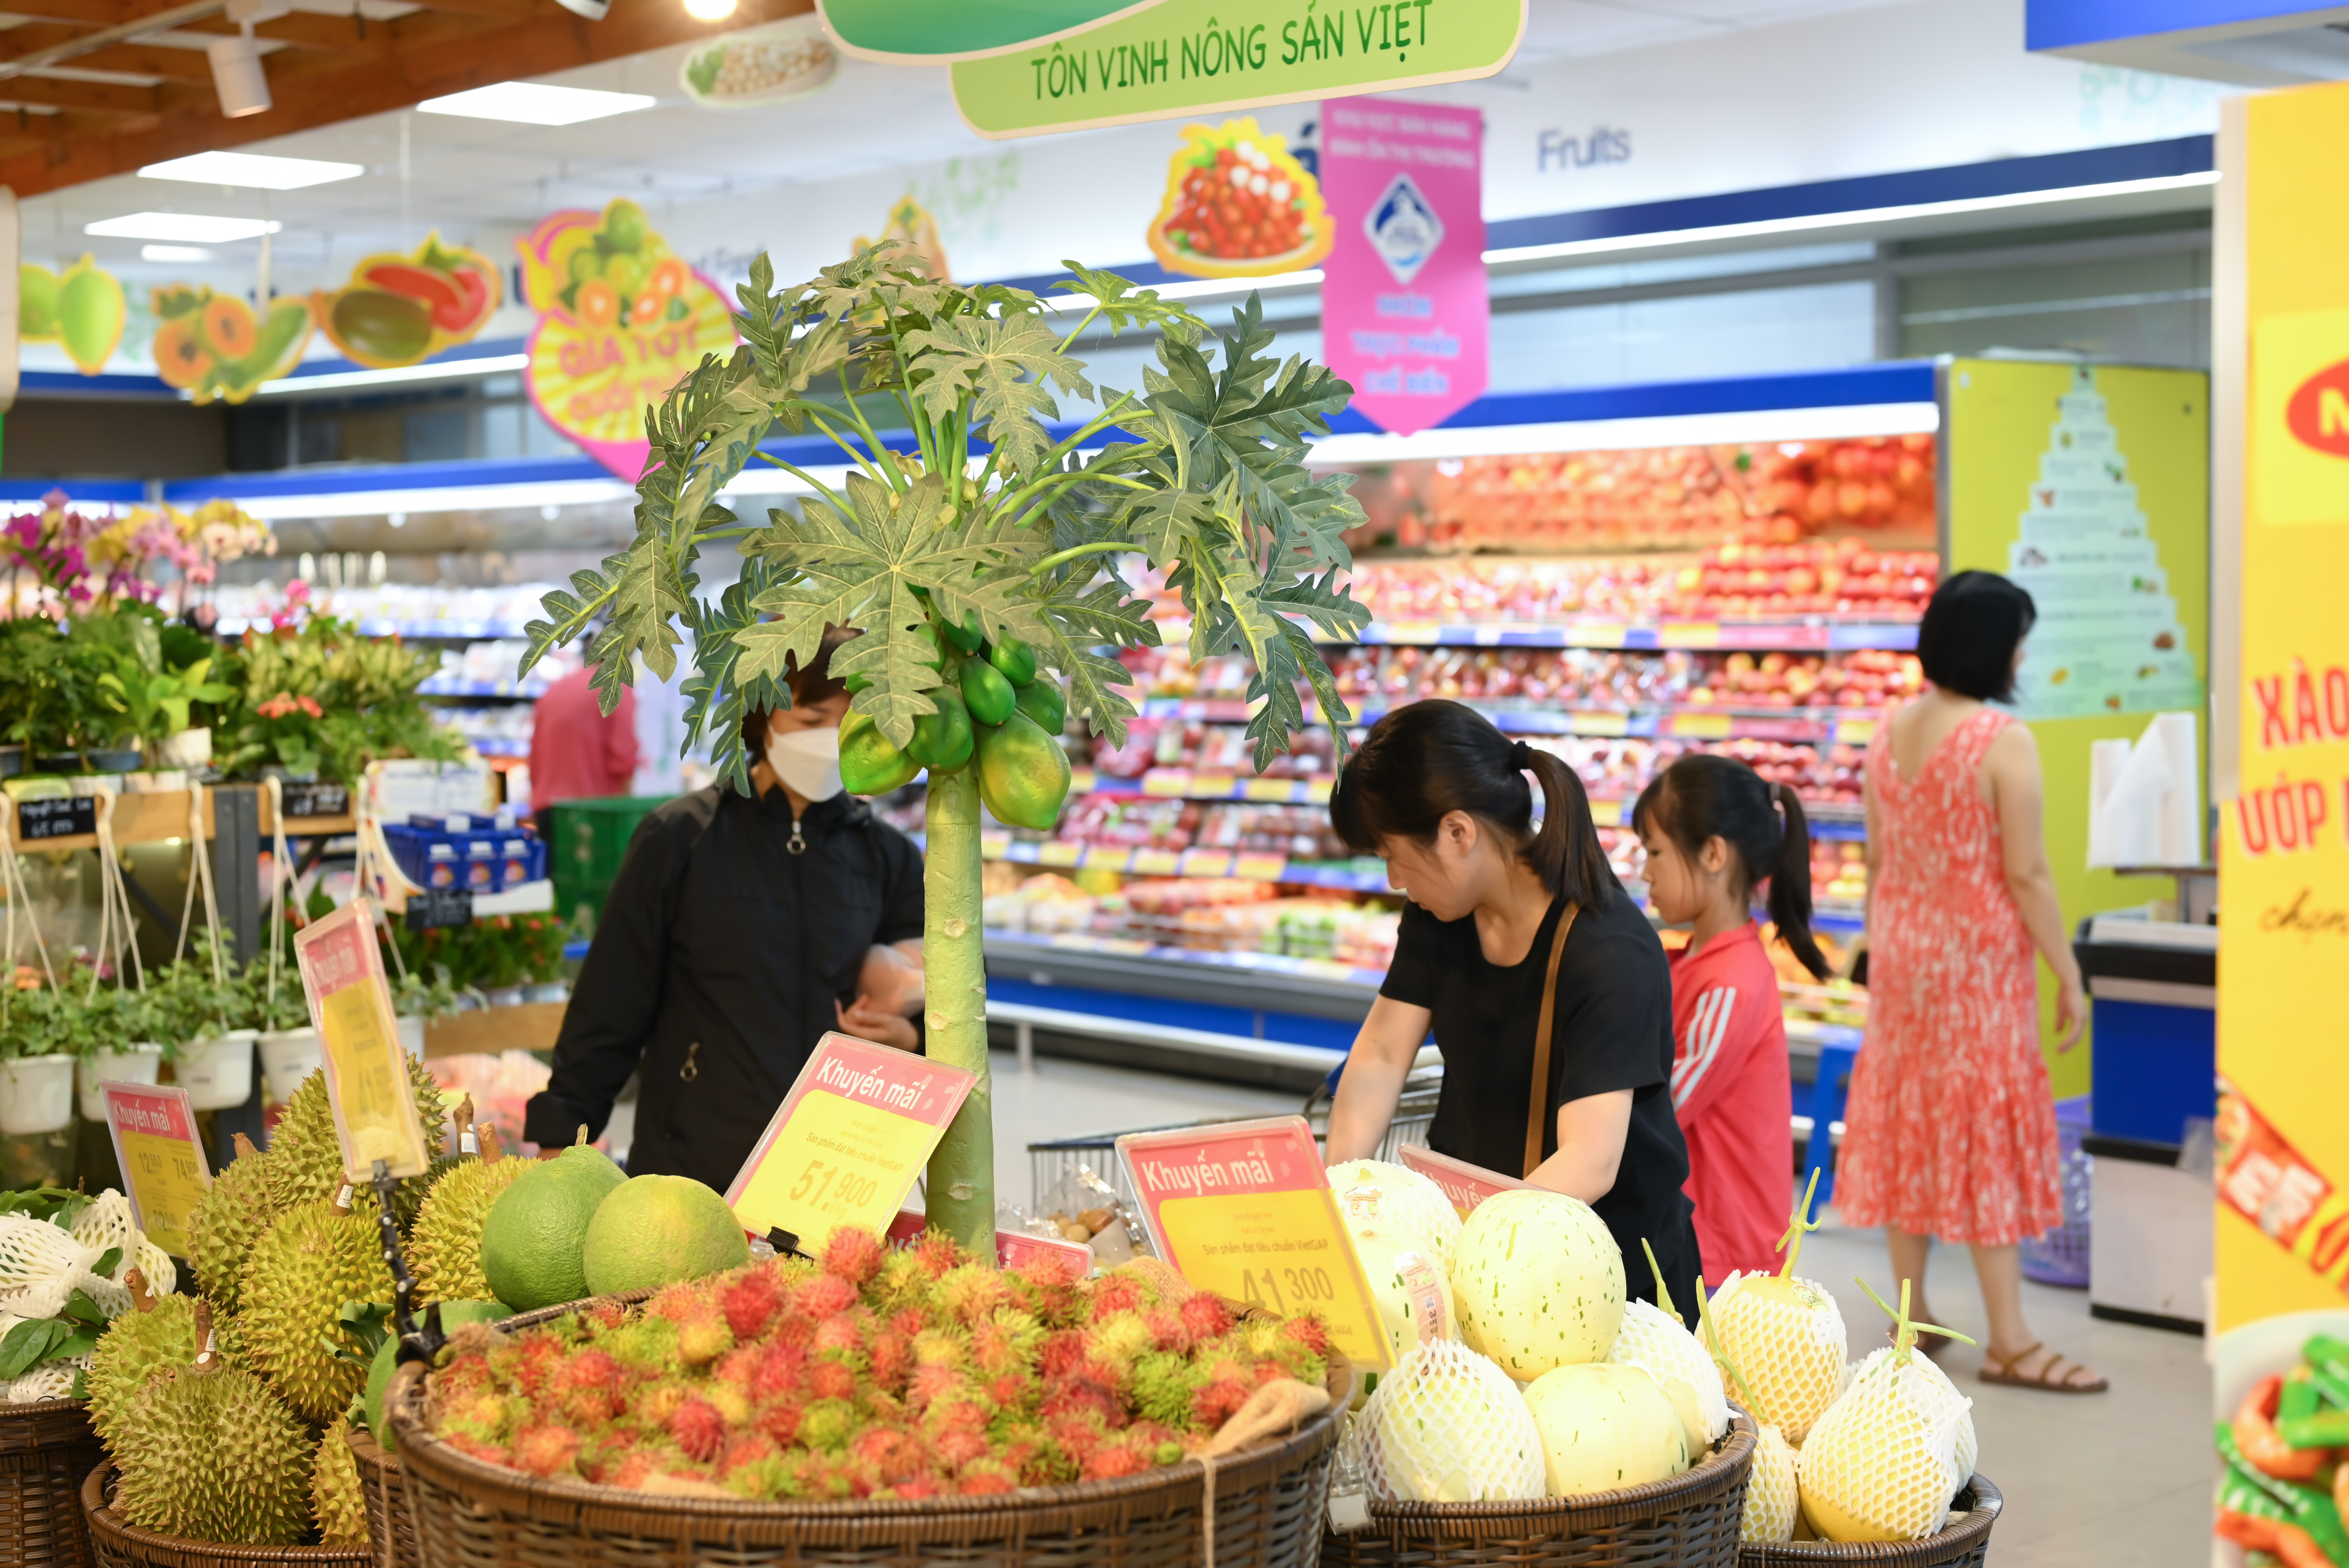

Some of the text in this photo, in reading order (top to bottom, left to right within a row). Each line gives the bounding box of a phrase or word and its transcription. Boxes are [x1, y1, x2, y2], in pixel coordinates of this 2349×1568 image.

[1031, 41, 1086, 100] TÔN
[1097, 39, 1168, 91] VINH
[1182, 16, 1266, 80] NÔNG
[1282, 0, 1344, 65] SẢN
[1537, 127, 1633, 172] Fruits
[816, 1057, 925, 1110] Khuyến mãi
[112, 1099, 171, 1132] Khuyến mãi
[806, 1133, 904, 1172] Sản phẩm đạt tiêu chuẩn VietGAP
[1141, 1149, 1274, 1196] Khuyến mãi
[1415, 1168, 1489, 1210] huyế
[1203, 1244, 1219, 1255] Sản
[1220, 1240, 1242, 1256] phẩm
[1242, 1242, 1256, 1256] đạt
[1295, 1238, 1328, 1251] VietGAP
